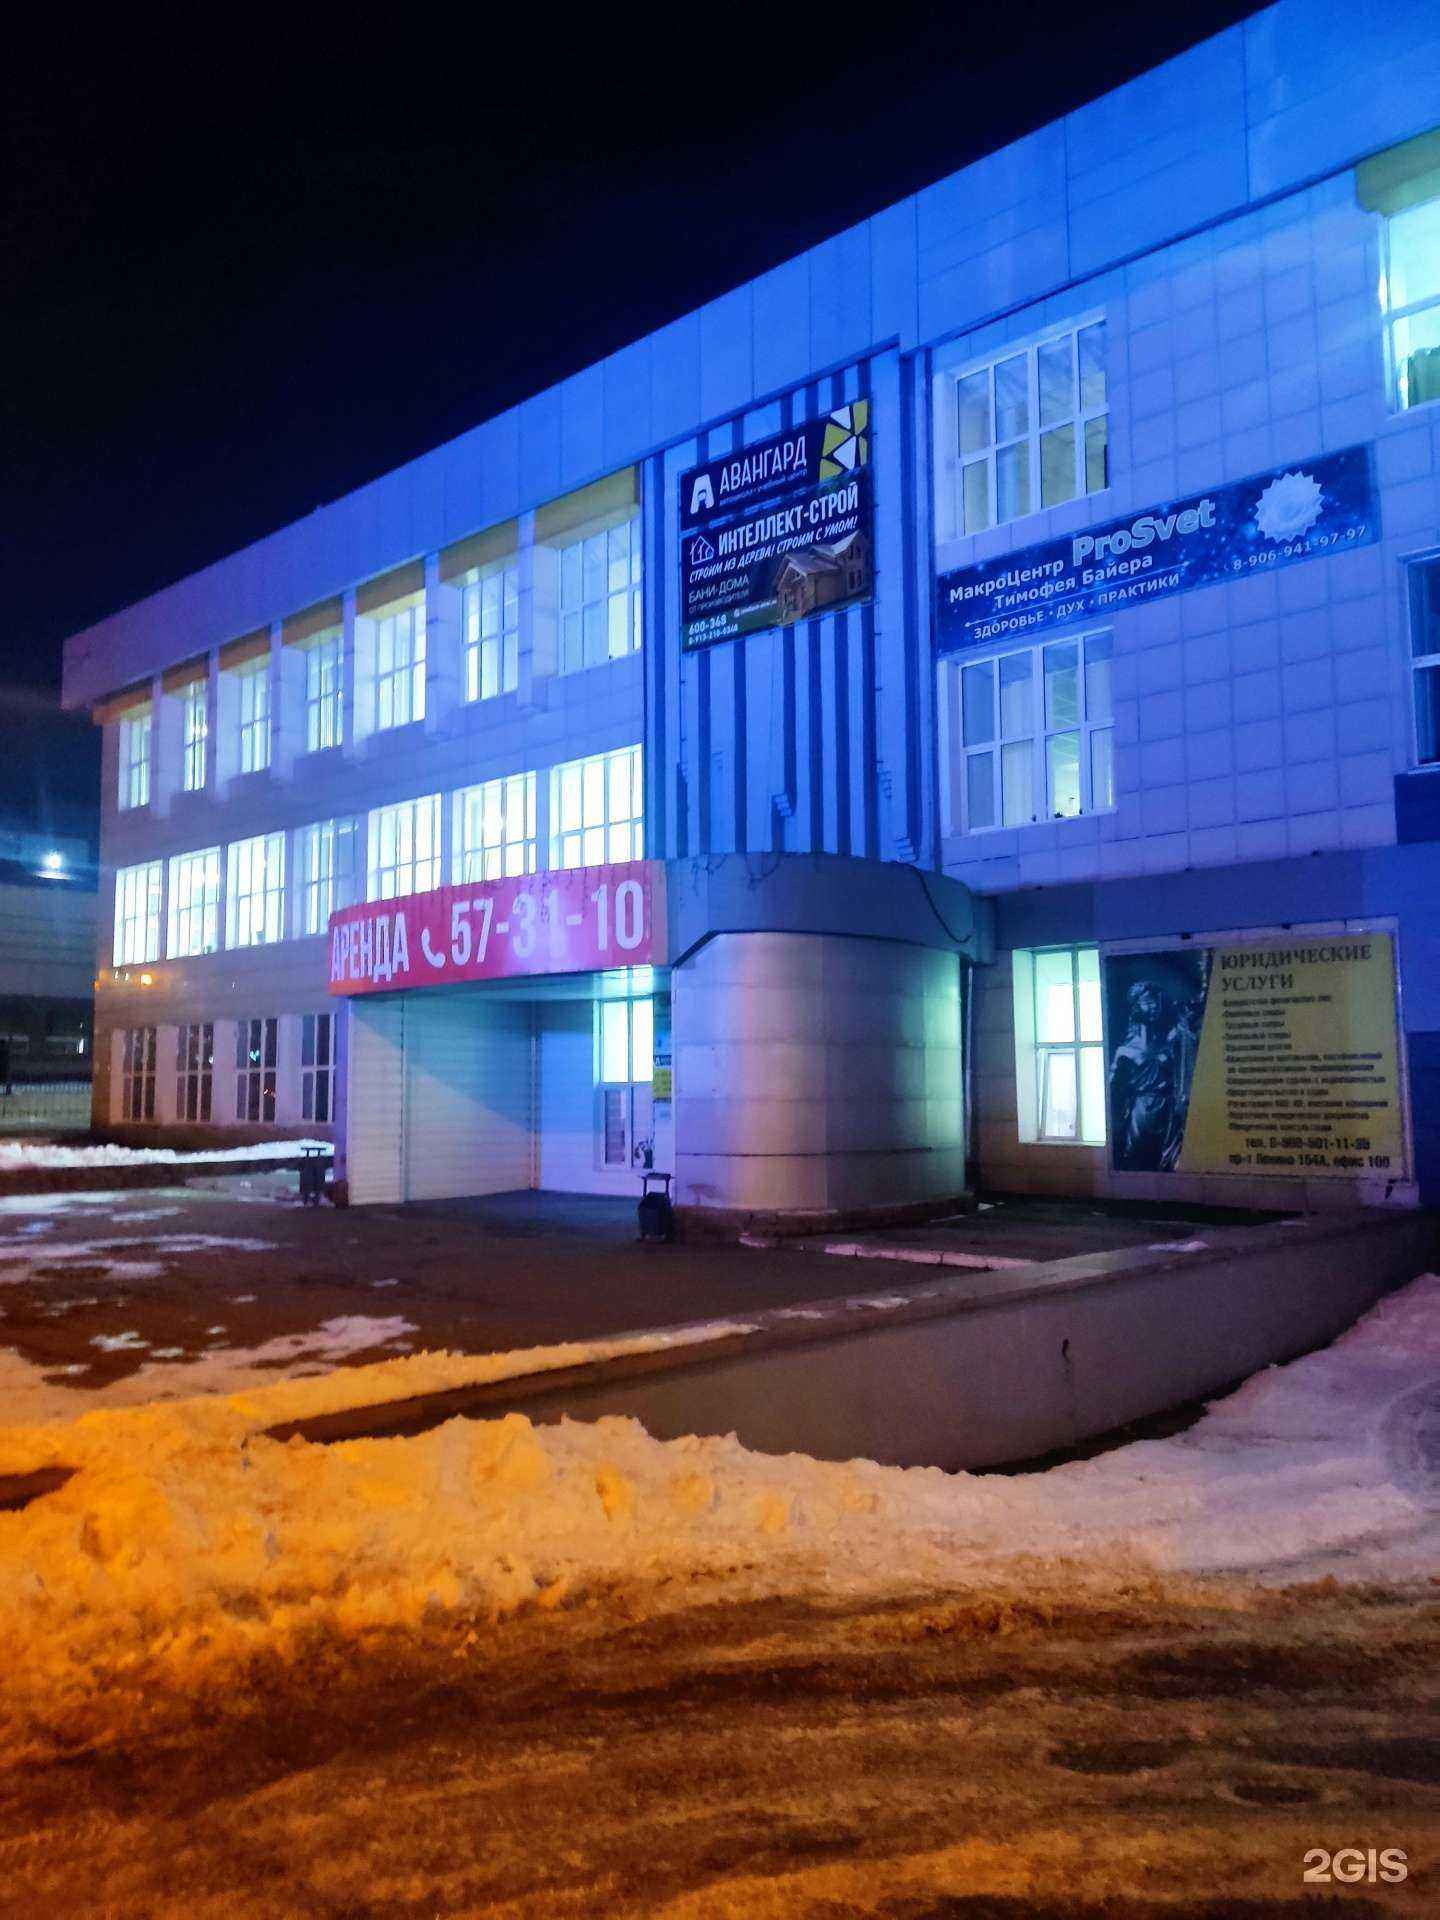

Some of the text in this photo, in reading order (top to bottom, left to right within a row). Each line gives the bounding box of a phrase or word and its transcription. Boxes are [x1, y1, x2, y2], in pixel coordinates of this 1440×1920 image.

[720, 435, 807, 495] АВАНГАРД
[689, 514, 859, 584] СТРОИМ ИЗ ДЕРЕВА! СТРОИМ С УМОМ!
[718, 481, 859, 557] ИНТЕЛЛЕКТ-СТРОЙ
[1073, 498, 1216, 567] ProSvet
[1232, 525, 1367, 571] 8-906-941-97-97
[949, 557, 1064, 604] МакроЦентр
[974, 572, 1180, 640] ЗДОРОВЬЕ ДУХ ПРАКТИКИ
[993, 555, 1153, 610] Тимофея Байера
[330, 879, 645, 984] АРЕНДА 57-31-10
[1221, 944, 1373, 971] ЮРИДИЧЕСКИЕ
[1221, 973, 1294, 992] УСЛУГИ
